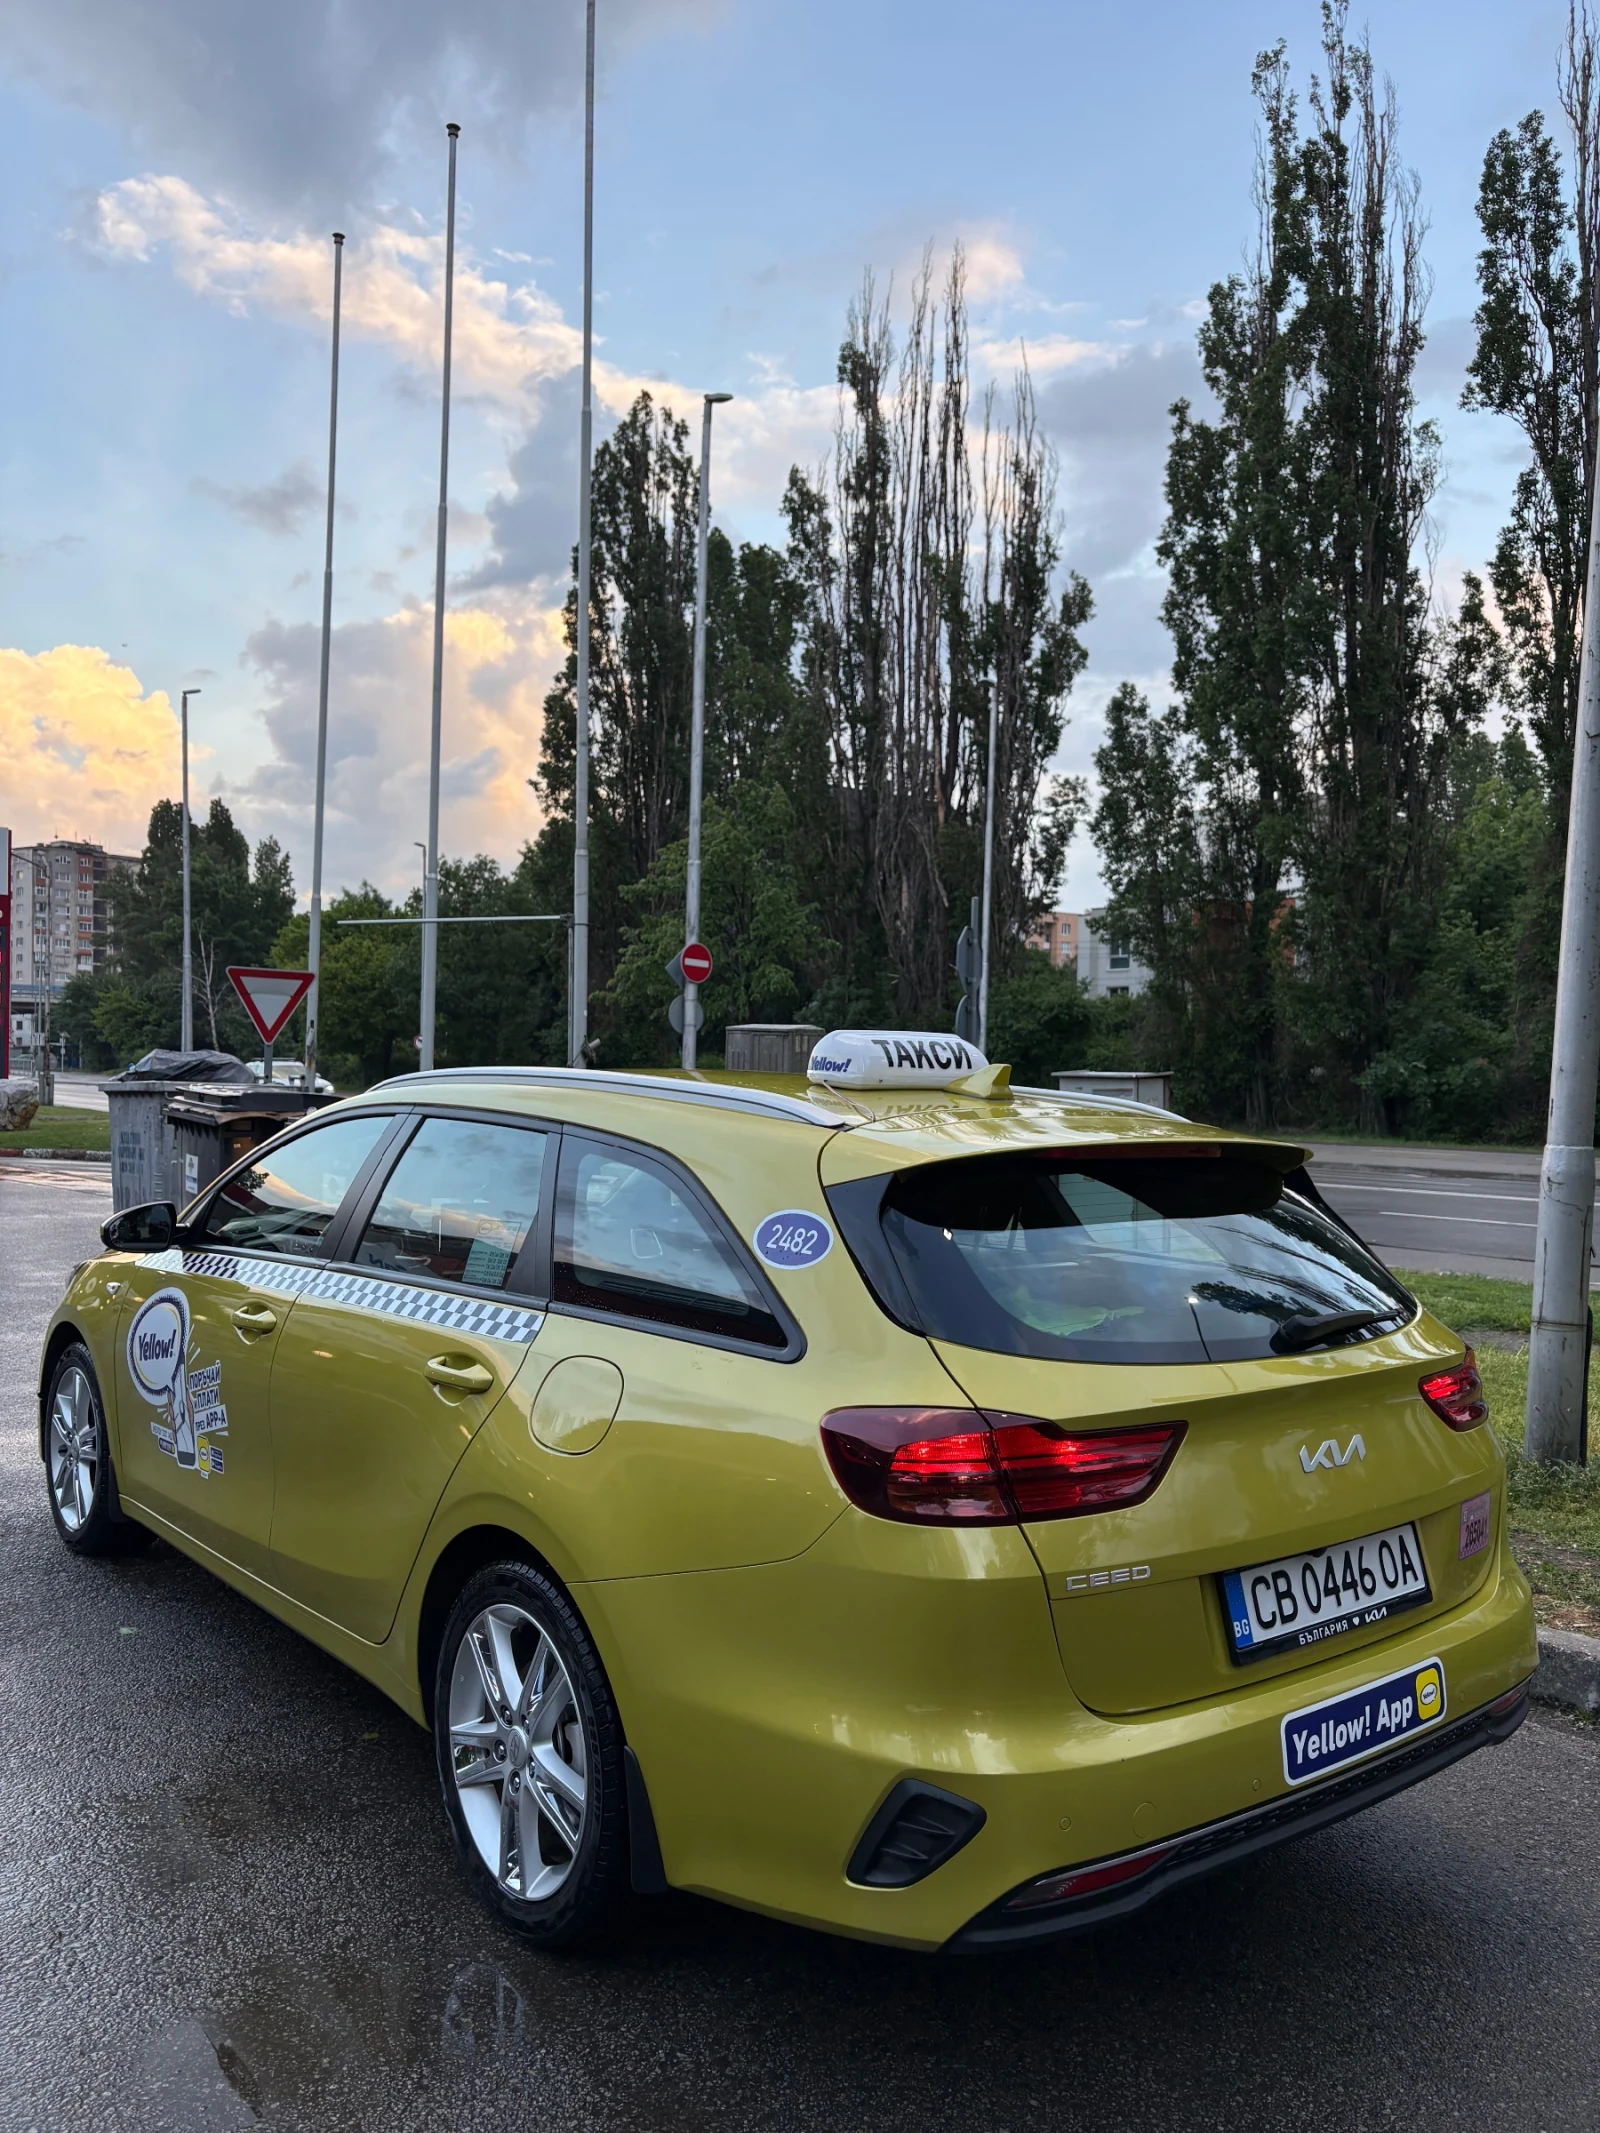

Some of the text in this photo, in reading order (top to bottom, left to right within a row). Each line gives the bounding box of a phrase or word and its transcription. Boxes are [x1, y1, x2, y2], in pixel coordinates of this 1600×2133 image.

[812, 1055, 852, 1073] Yellow!
[871, 1039, 973, 1070] ТАКСИ
[766, 1224, 818, 1255] 2482
[138, 1329, 177, 1362] Yellow!
[190, 1361, 220, 1390] ПОРЪЧАЙ
[198, 1388, 219, 1409] ПЛАТИ
[1299, 1434, 1366, 1473] KIA
[1066, 1565, 1151, 1591] CEED
[1233, 1619, 1250, 1638] BG
[1299, 1606, 1388, 1645] БЪЛГАРИЯ KIA
[1292, 1696, 1413, 1765] Yellow! App
